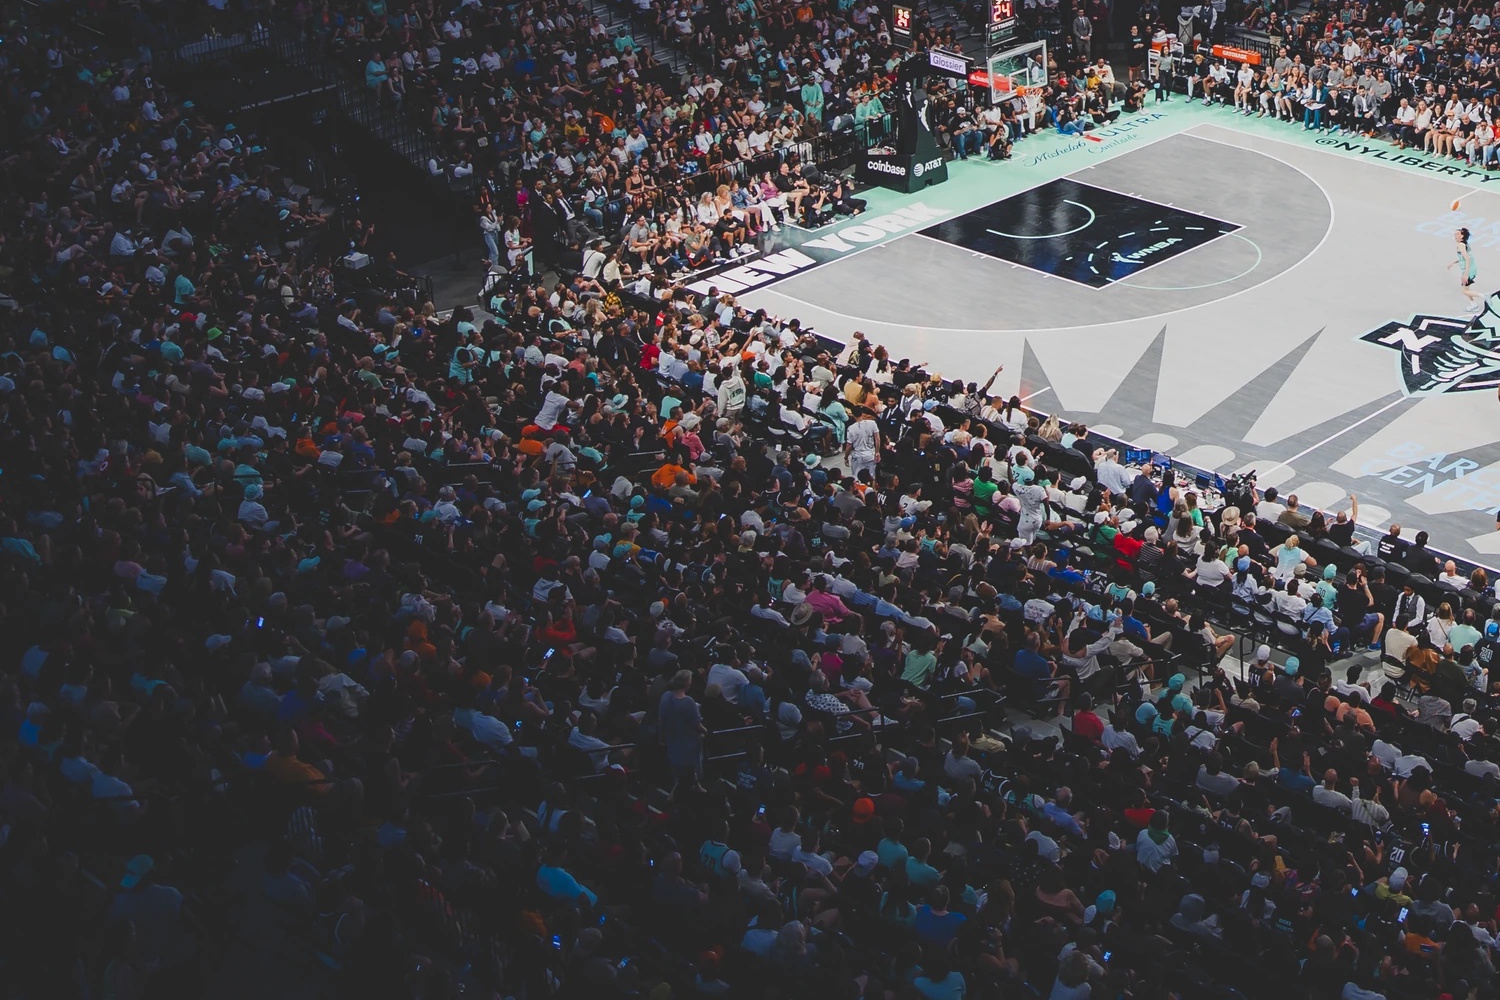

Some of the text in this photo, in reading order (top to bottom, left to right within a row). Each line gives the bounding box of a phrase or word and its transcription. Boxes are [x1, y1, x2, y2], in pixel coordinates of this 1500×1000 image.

[993, 4, 1010, 23] 24
[1102, 113, 1169, 137] ULTRA
[924, 157, 944, 172] AT&T
[1024, 141, 1087, 167] Michelob
[868, 160, 906, 176] coinbase
[801, 201, 953, 253] YORK
[1127, 238, 1183, 259] WNBA
[685, 248, 817, 298] NEW
